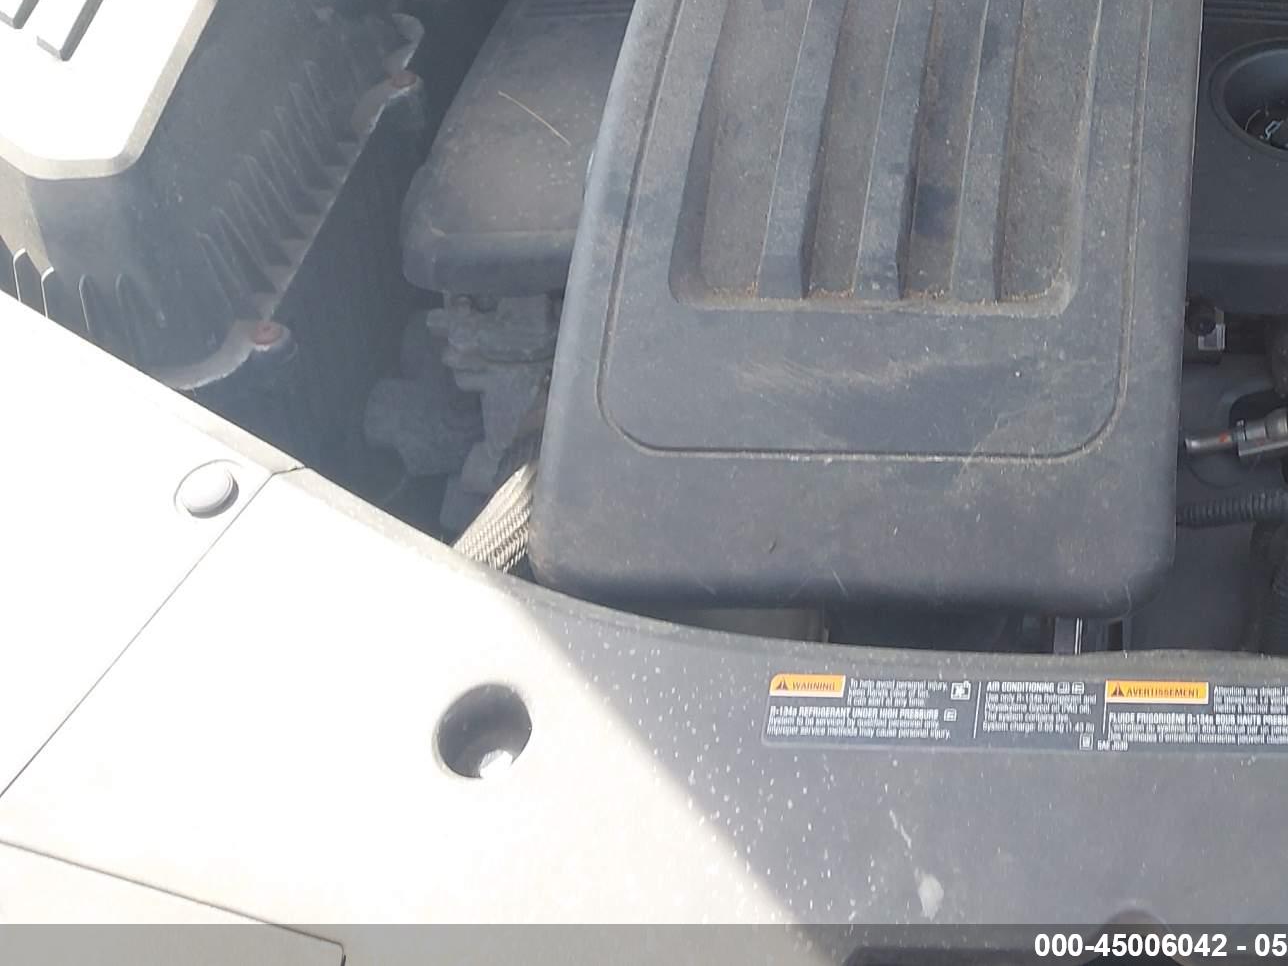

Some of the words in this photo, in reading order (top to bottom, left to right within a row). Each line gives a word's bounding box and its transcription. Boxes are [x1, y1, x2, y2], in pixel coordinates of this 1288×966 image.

[792, 681, 836, 692] WARNING
[1001, 681, 1055, 692] CONDITIONING
[1126, 686, 1200, 698] AVERTISSEMENT
[798, 706, 851, 717] REFRIGERANT
[852, 707, 878, 718] UNDER
